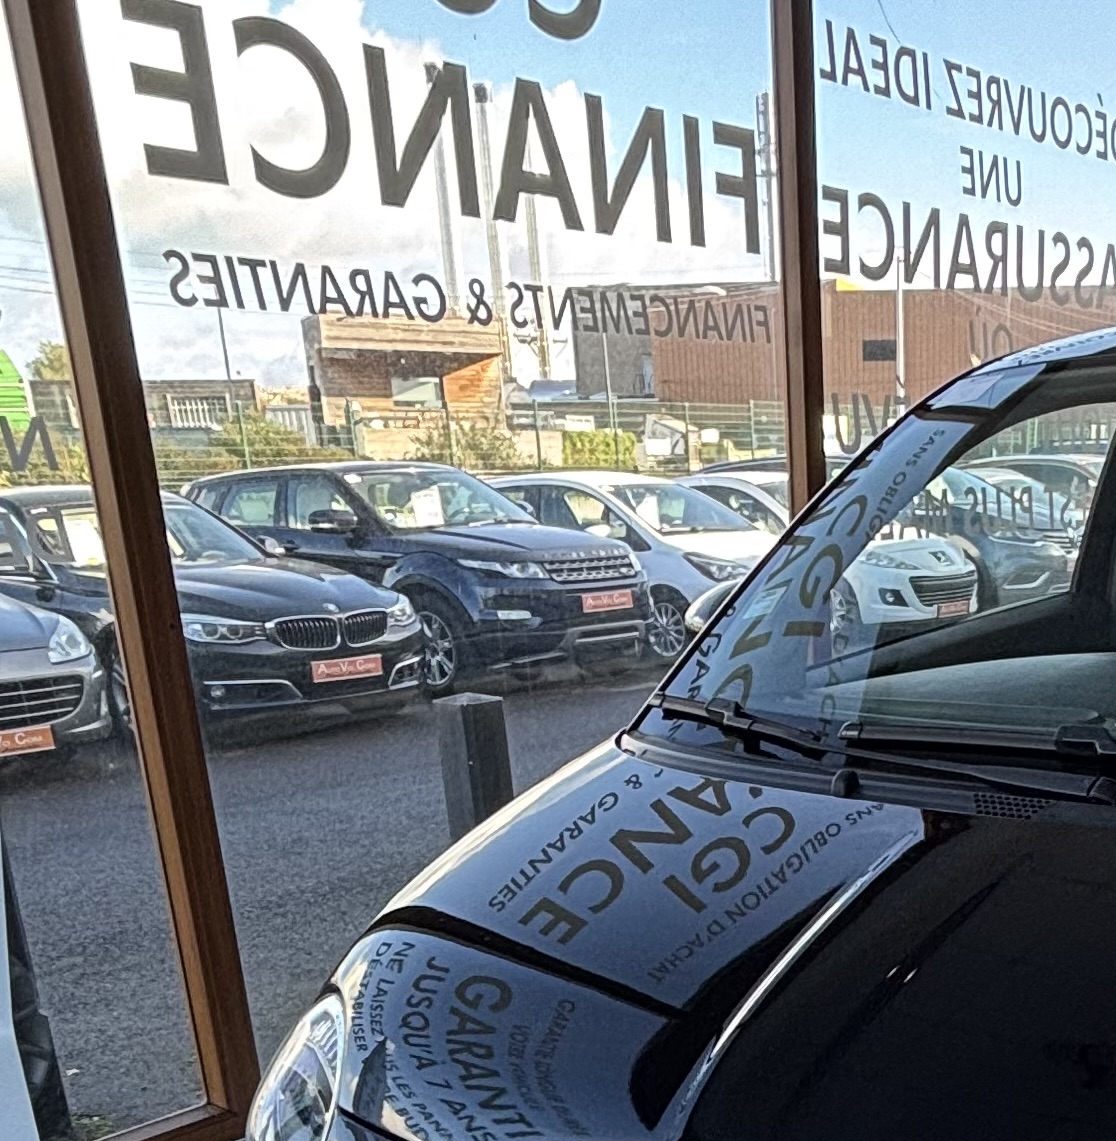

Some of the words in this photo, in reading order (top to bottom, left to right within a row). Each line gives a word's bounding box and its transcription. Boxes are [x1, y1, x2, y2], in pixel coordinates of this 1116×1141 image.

[487, 791, 621, 913] GARANTIES
[724, 821, 842, 926] OBLIGATION
[369, 977, 395, 1037] LAISSEZ
[386, 941, 416, 974] NE
[446, 975, 547, 1140] GARANTI
